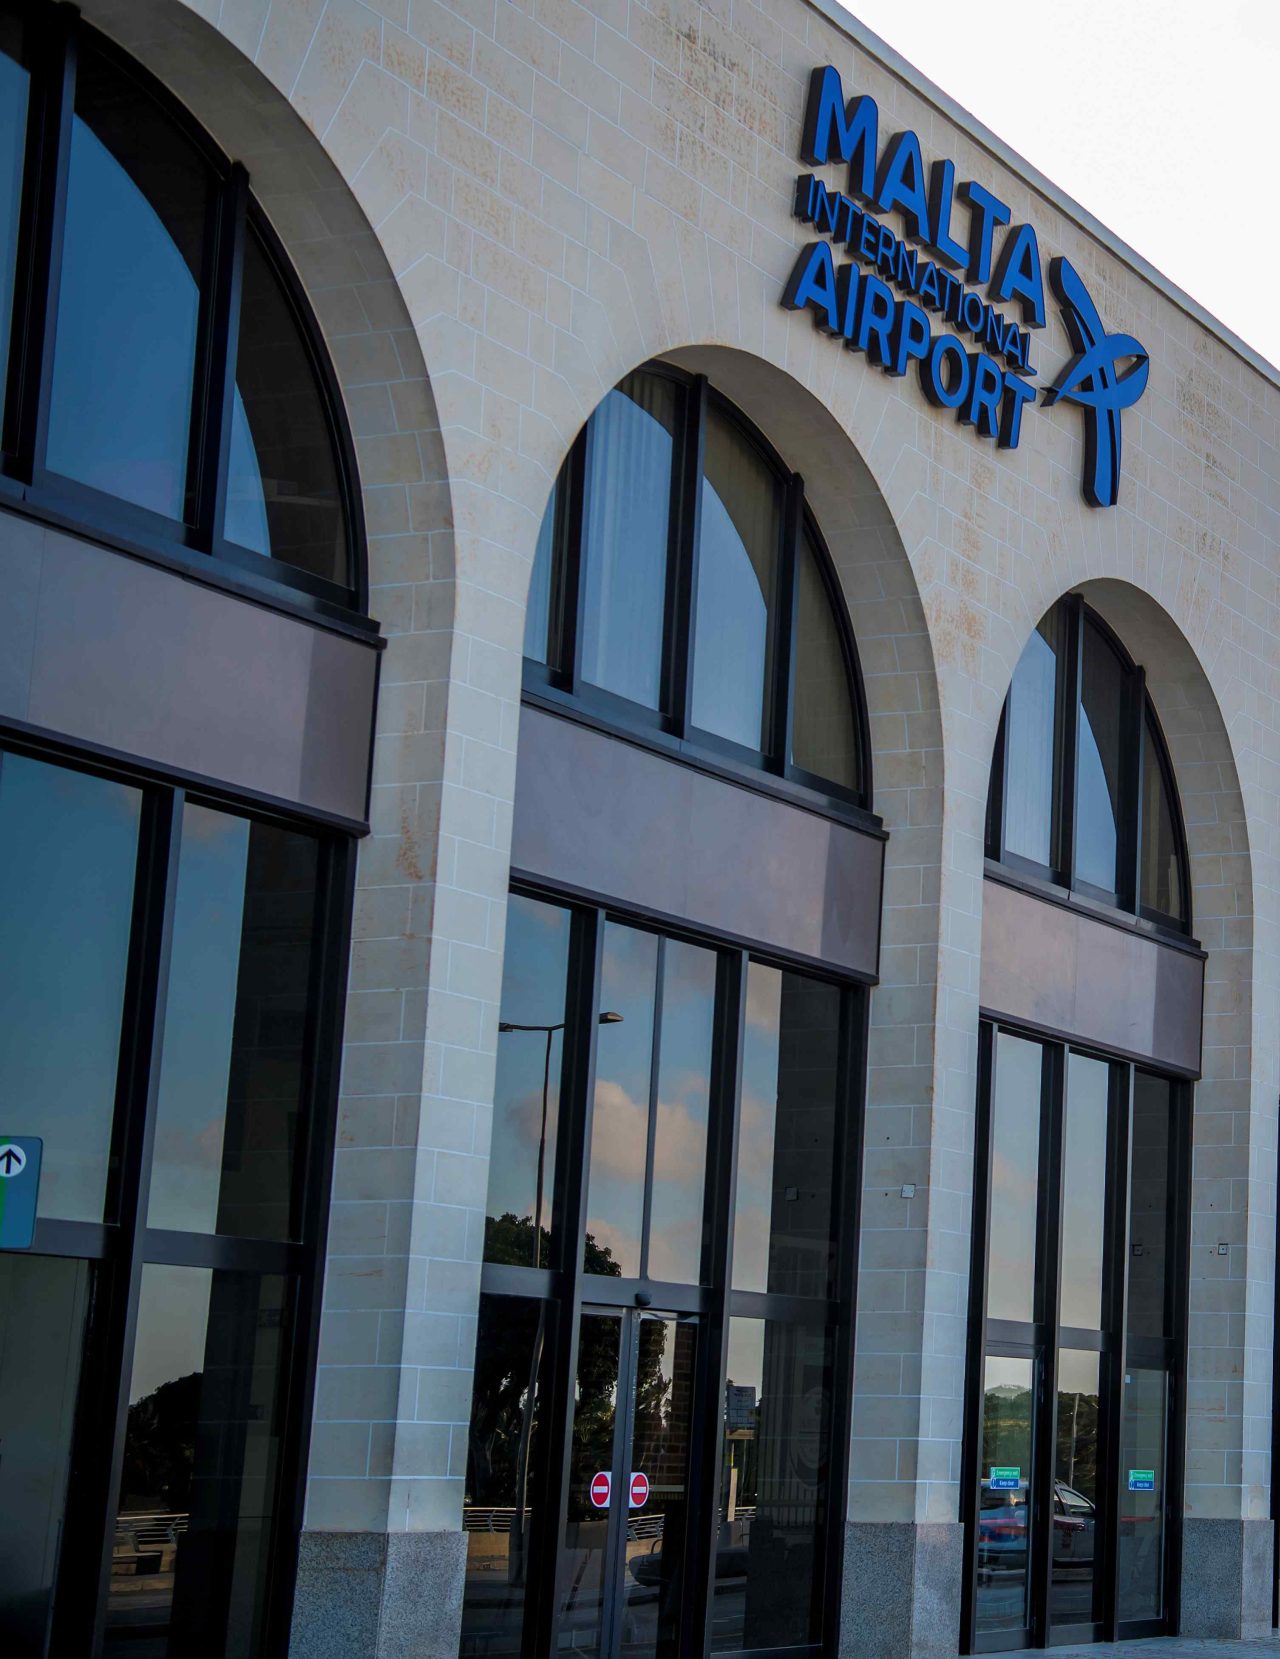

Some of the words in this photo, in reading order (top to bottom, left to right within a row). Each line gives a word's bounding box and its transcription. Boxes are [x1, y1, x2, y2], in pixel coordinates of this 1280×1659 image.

[794, 173, 1038, 377] INTERNATIONAL
[801, 65, 1046, 328] MALTA
[781, 241, 1036, 449] AIRPORT
